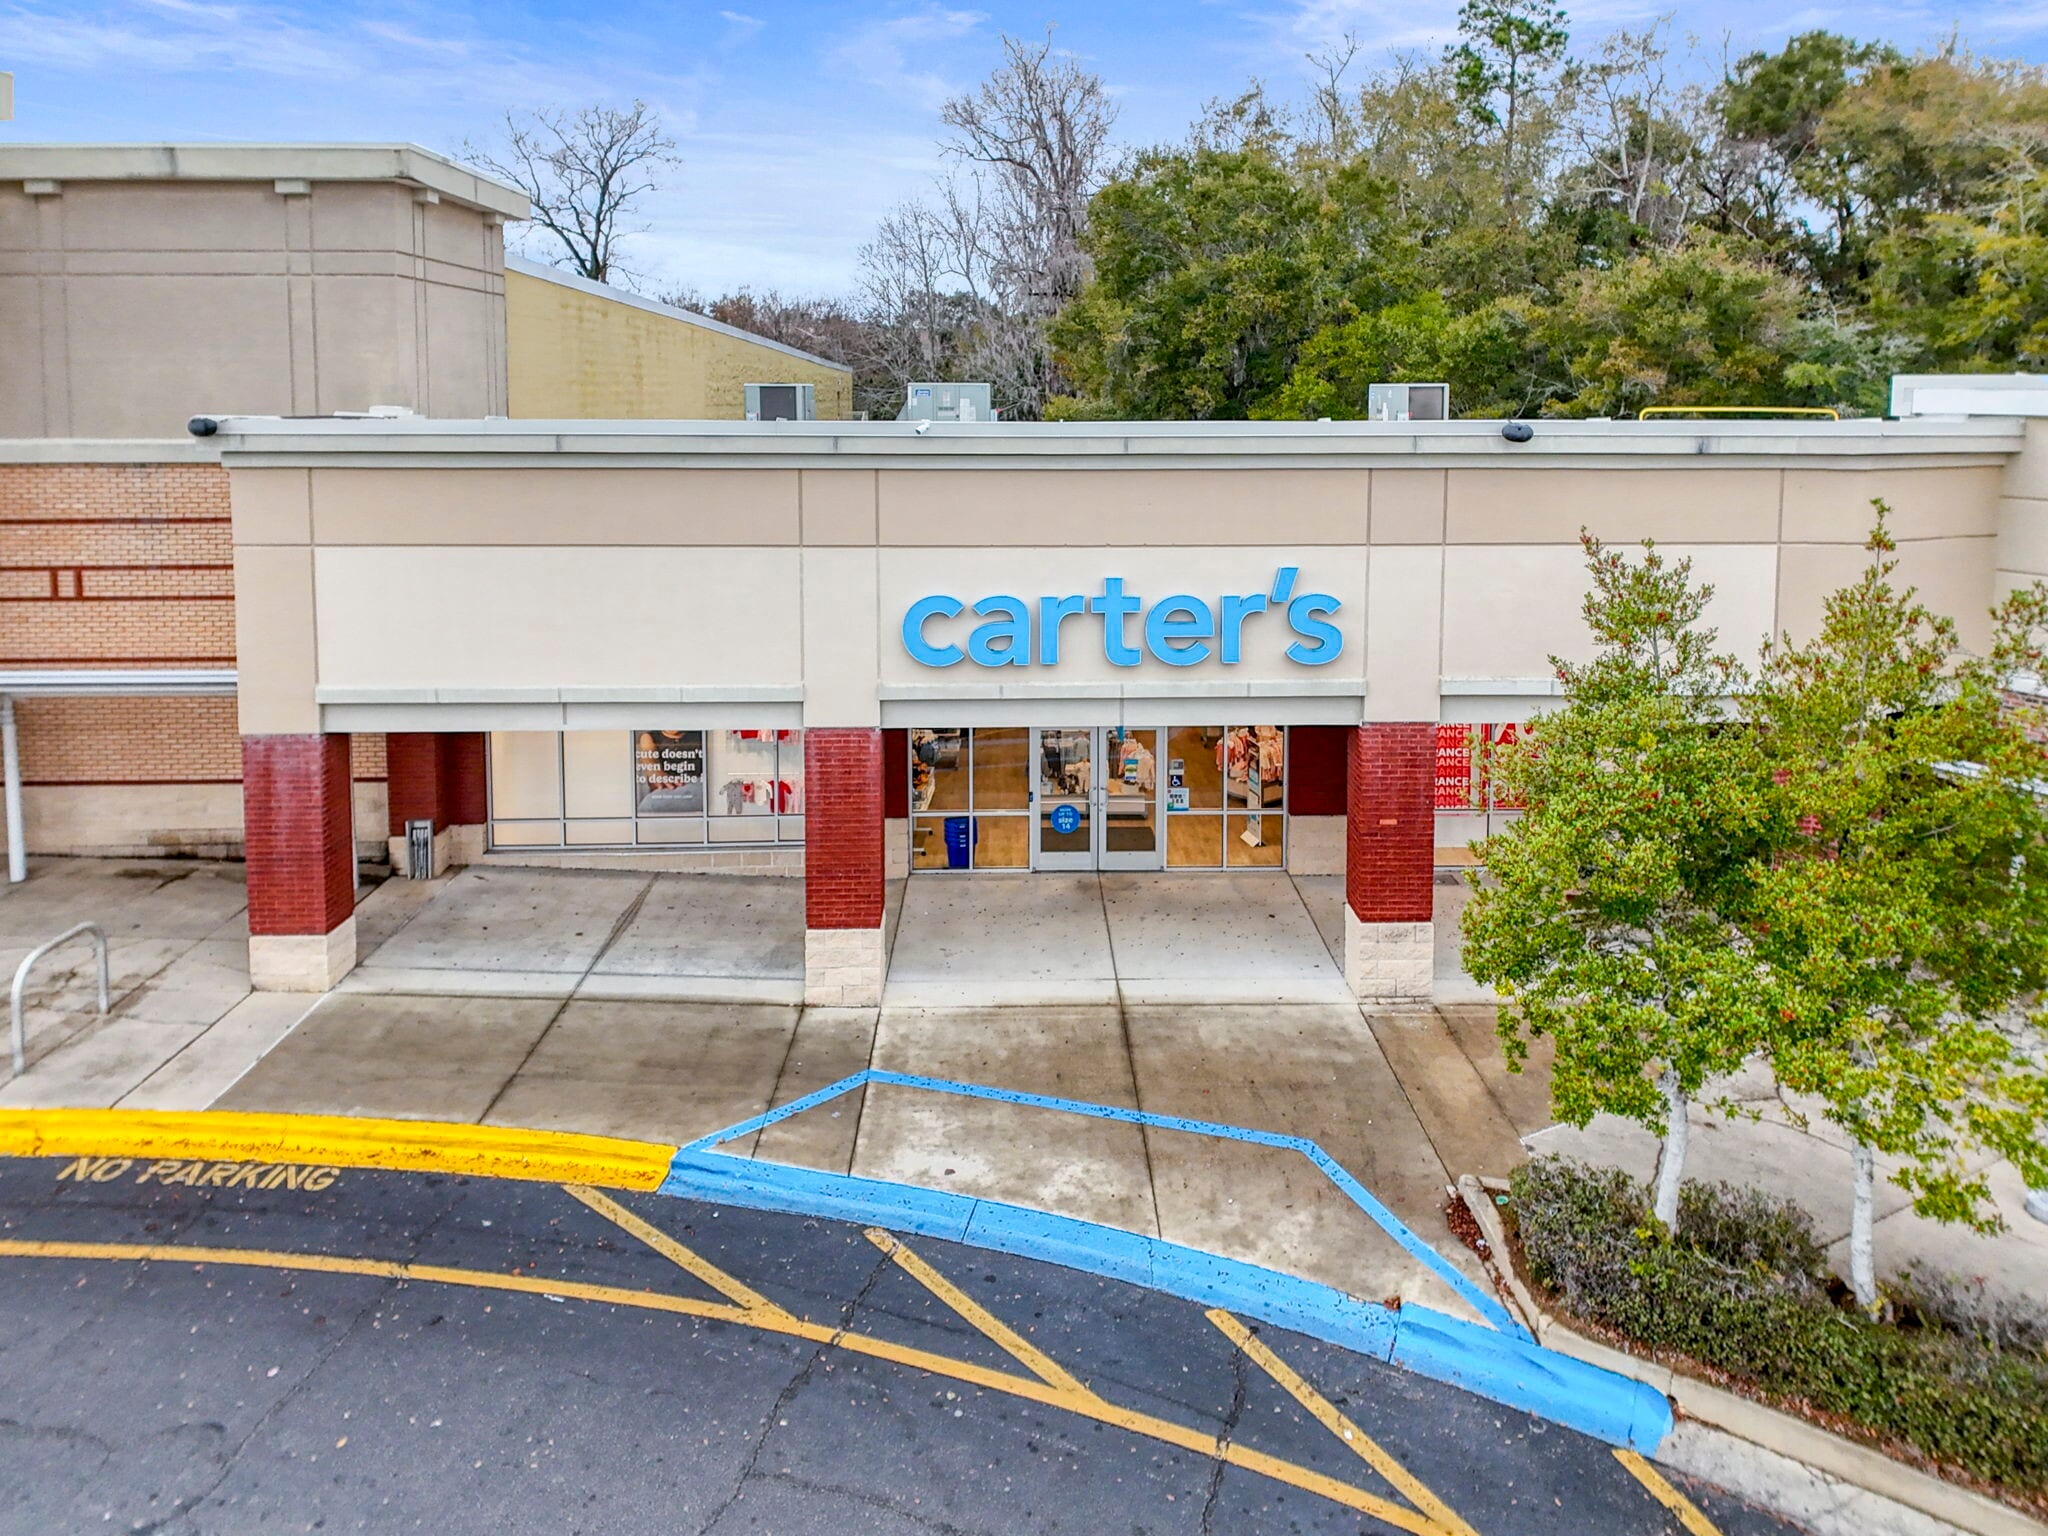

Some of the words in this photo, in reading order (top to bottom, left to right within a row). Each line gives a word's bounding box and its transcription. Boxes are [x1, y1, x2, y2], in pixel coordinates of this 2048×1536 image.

[902, 567, 1344, 667] carter's
[1437, 739, 1469, 747] ANC
[661, 748, 703, 759] doesn't
[663, 761, 695, 773] begin
[648, 774, 697, 784] describe
[56, 1157, 132, 1182] NO
[136, 1160, 341, 1192] PARKING
